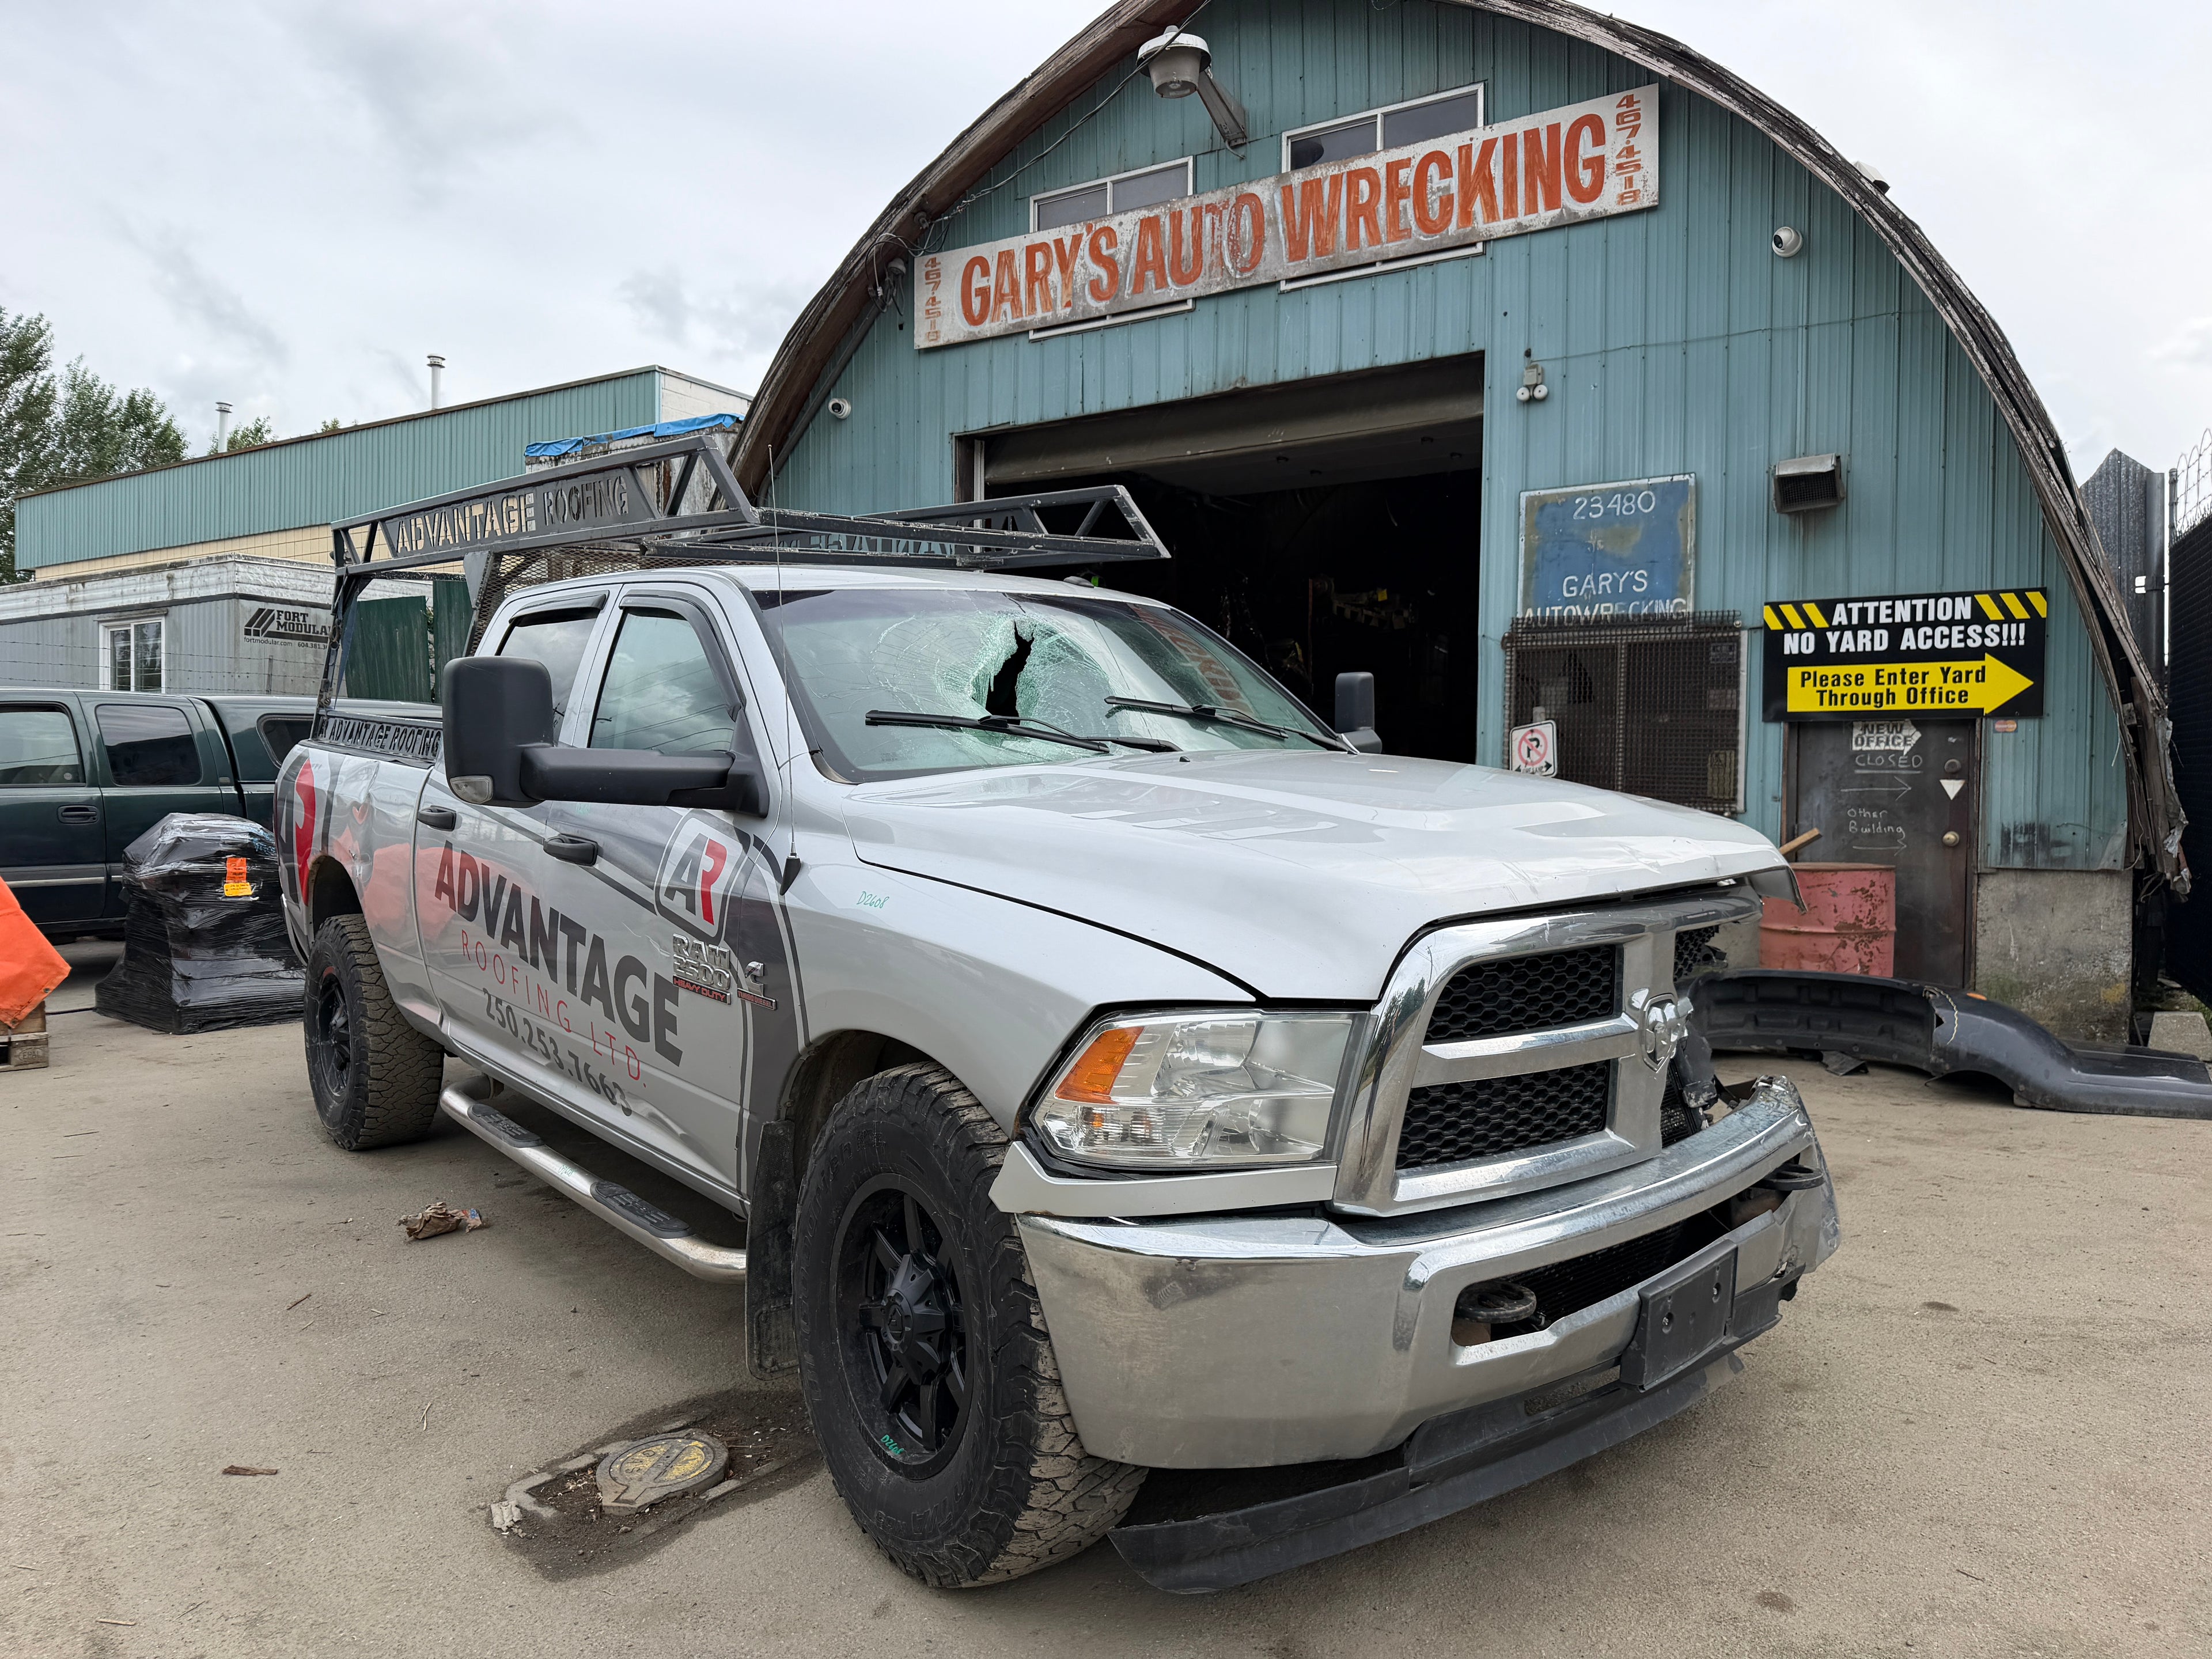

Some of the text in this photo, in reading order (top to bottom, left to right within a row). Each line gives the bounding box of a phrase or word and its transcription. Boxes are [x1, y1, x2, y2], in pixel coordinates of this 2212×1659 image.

[960, 113, 1606, 327] GARY'S AUTO WRECKING
[396, 476, 628, 554] ADVANTAGE ROOFING
[1573, 490, 1656, 520] 23480
[1562, 570, 1648, 597] GARY'S
[276, 609, 309, 623] FORT
[1831, 596, 1972, 626] ATTENTION
[276, 620, 331, 635] MODULA
[1783, 623, 2026, 655] NO YARD ACCESS!!!
[244, 638, 293, 646] fortmodular.com
[1800, 665, 1987, 688] Please Enter Yard
[1816, 687, 1969, 709] Through Office
[329, 718, 392, 749] ADVANTAGE
[389, 727, 442, 757] ROOFING
[1863, 722, 1903, 734] NEW
[1854, 734, 1913, 748] OFFICE
[1855, 753, 1923, 768] CLOSED
[1847, 808, 1888, 819] Other
[1849, 820, 1906, 839] Building
[856, 891, 890, 908] D2608
[435, 840, 684, 1067] ADVANTAGE
[672, 933, 730, 968] RAM
[462, 929, 571, 1033] ROOFING
[673, 953, 731, 991] 2500
[673, 977, 726, 1001] HEAVY DUTY
[482, 987, 633, 1117] 250.253.7663
